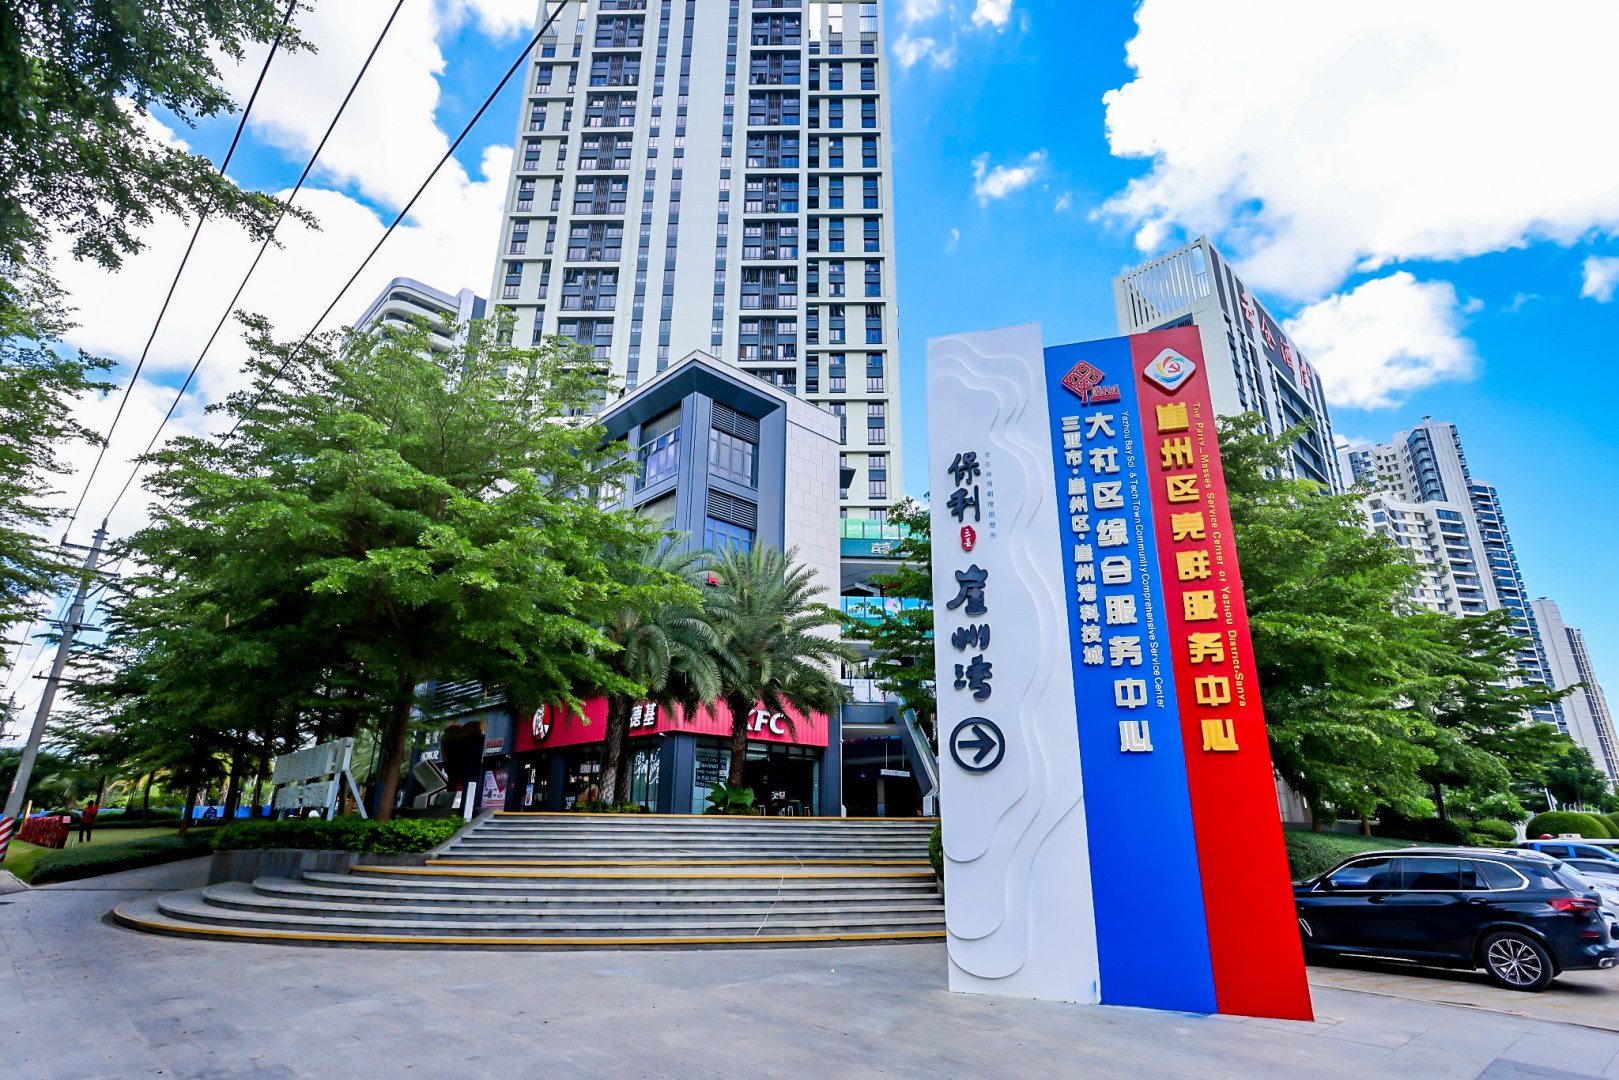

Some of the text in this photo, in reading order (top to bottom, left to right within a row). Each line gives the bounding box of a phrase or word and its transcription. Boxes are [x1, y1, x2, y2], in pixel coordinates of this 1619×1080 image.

[1121, 410, 1130, 439] Yazhou
[1124, 440, 1133, 455] Bay
[946, 451, 981, 523] 保利
[1130, 480, 1138, 499] Tech
[1132, 501, 1141, 524] Town
[1192, 402, 1200, 419] The
[1206, 492, 1218, 528] Service
[1212, 531, 1223, 565] Center
[1221, 586, 1233, 625] Yazhou
[1135, 524, 1147, 573] Community
[1085, 411, 1154, 753] 大社区综合服务中心
[1155, 401, 1240, 752] 崖州区党群服务中心
[1141, 573, 1155, 641] Comprehensive
[946, 564, 993, 701] 崖州湾
[1150, 641, 1160, 676] Service
[1154, 677, 1165, 709] Center
[629, 702, 657, 728] 德基
